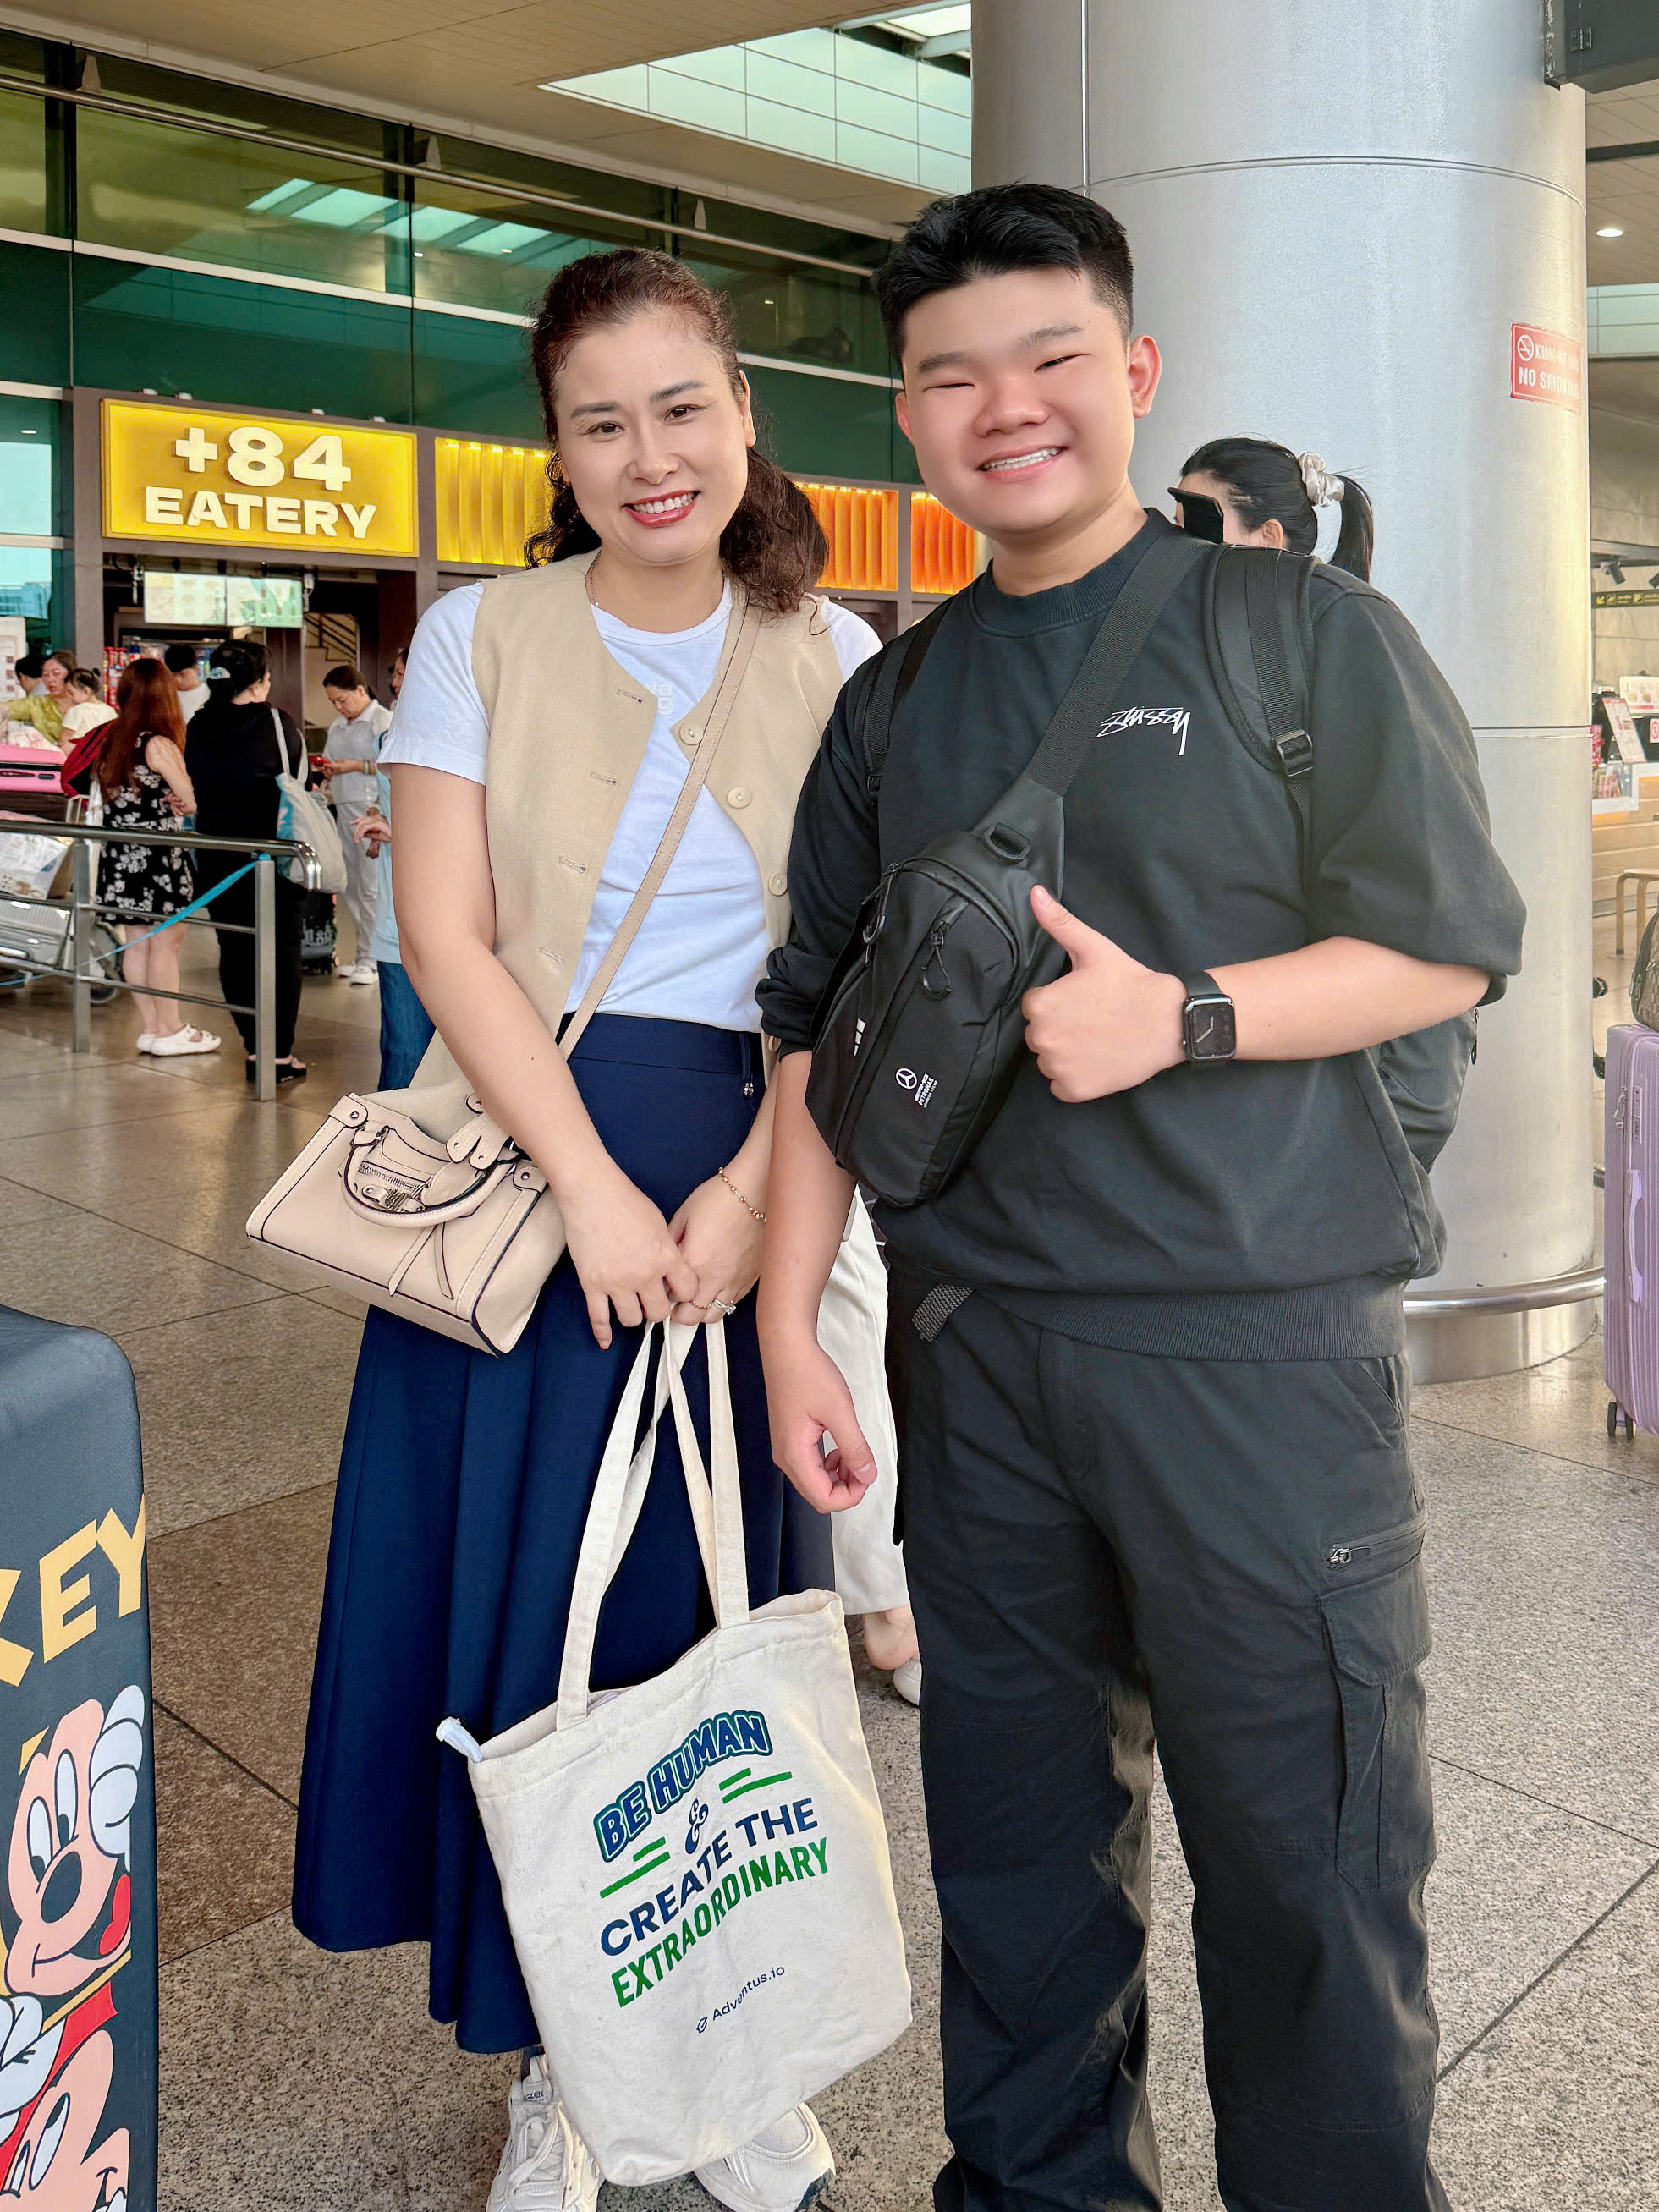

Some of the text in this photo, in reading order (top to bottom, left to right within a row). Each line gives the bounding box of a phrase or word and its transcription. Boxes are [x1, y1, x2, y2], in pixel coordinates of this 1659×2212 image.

[1518, 366, 1536, 387] NO
[174, 426, 352, 491] +84
[145, 486, 377, 540] EATERY
[593, 1710, 773, 1863] BE HUMAN
[685, 1798, 709, 1855] &
[600, 1797, 819, 1957] CREATE THE
[610, 1837, 829, 2008] EXTRAORDINARY
[711, 1965, 786, 2022] Adventus.io
